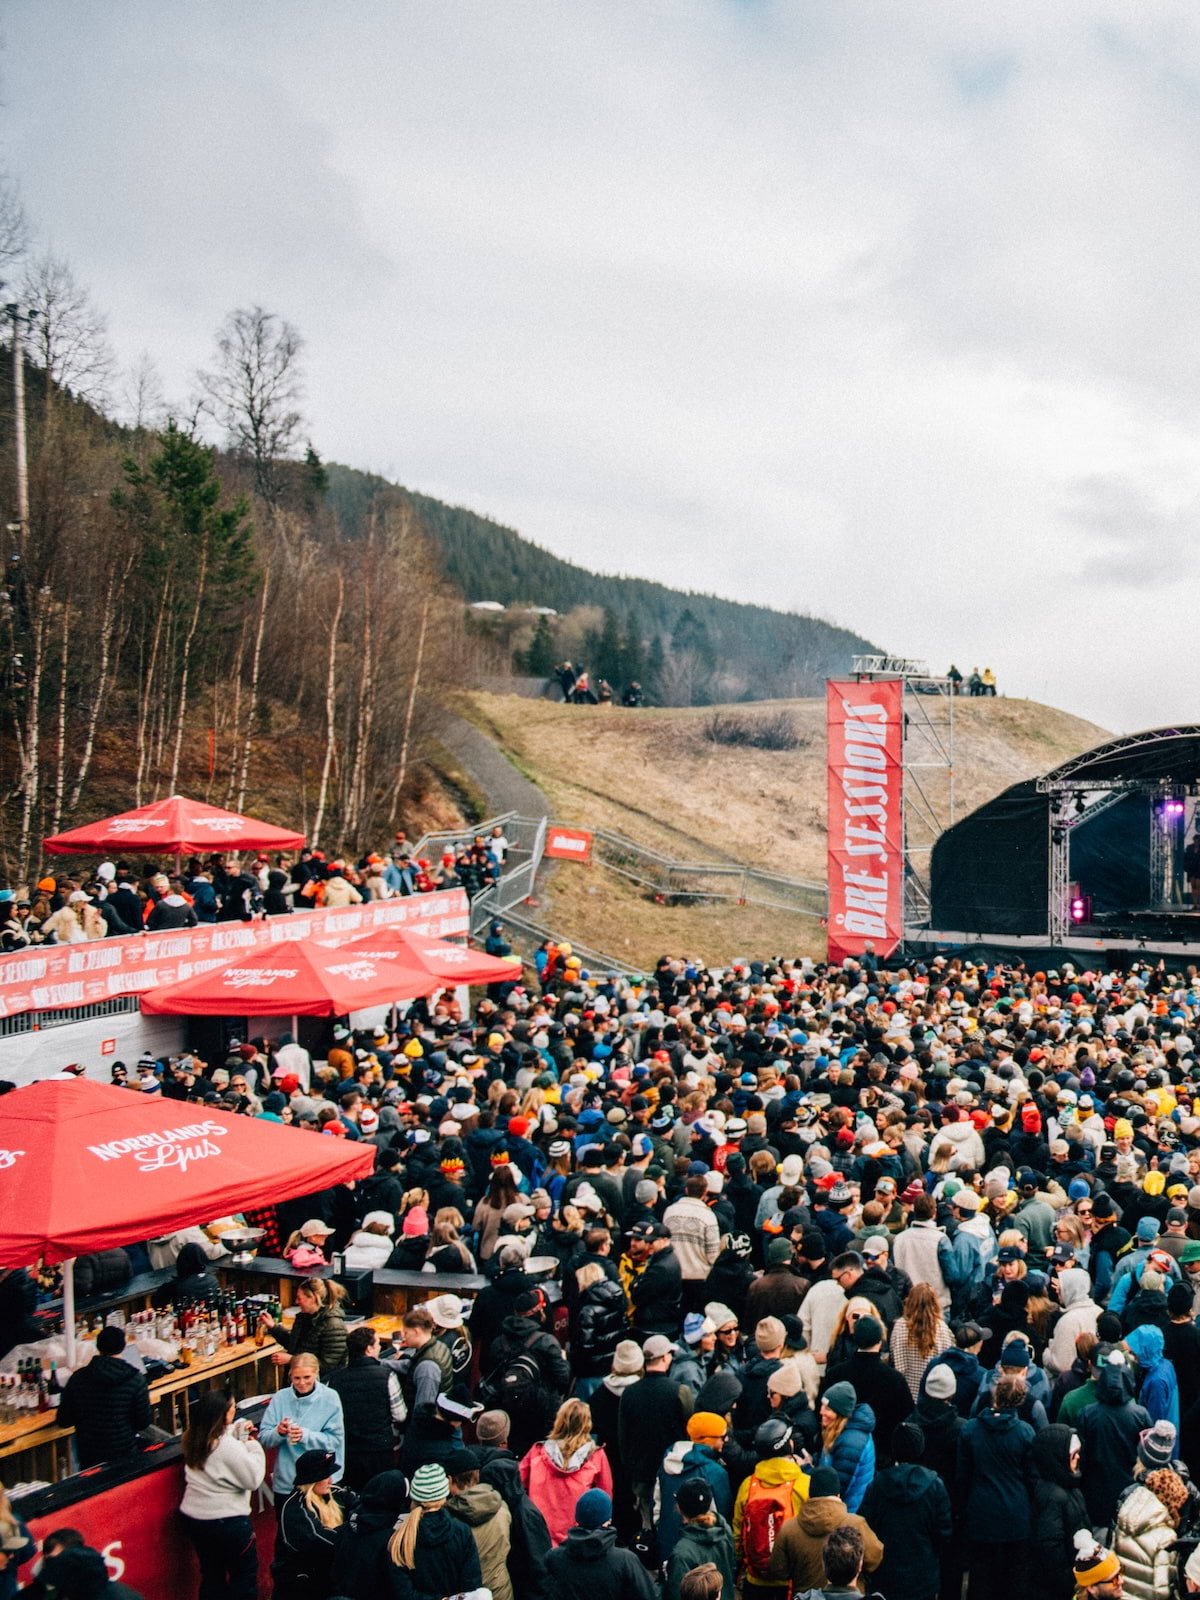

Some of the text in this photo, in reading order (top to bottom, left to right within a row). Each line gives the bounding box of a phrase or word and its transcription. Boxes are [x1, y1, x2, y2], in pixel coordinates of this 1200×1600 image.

[835, 700, 889, 939] ÅRE SESSIONS
[86, 1120, 229, 1161] NORRLANDS
[134, 1138, 222, 1173] Ljus
